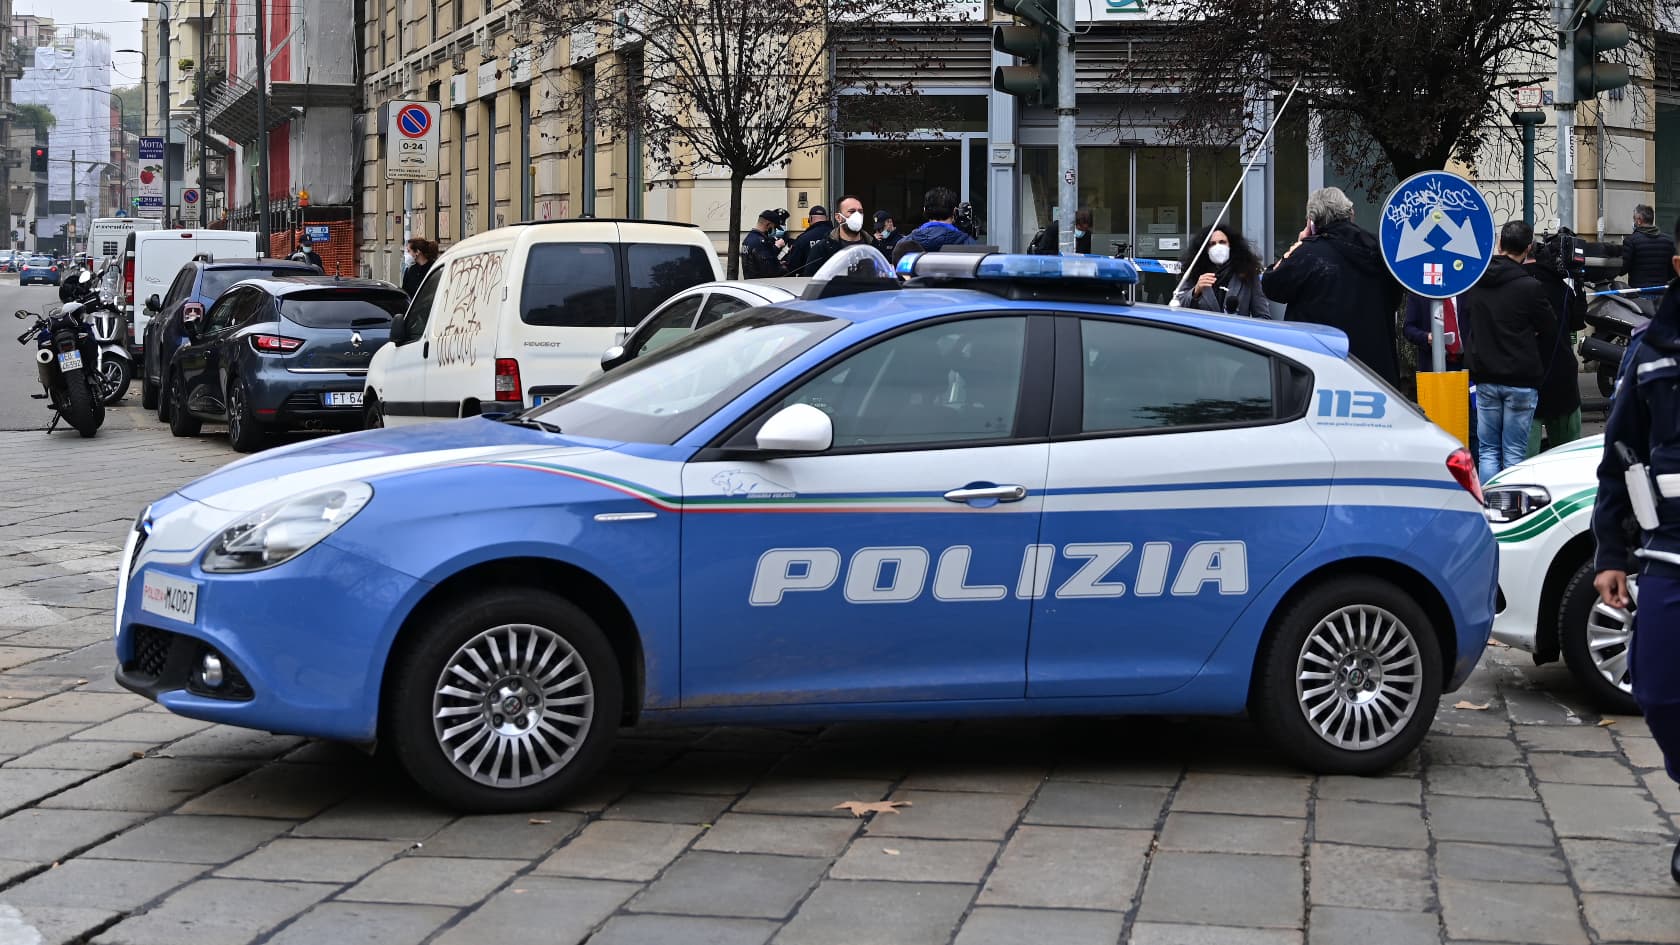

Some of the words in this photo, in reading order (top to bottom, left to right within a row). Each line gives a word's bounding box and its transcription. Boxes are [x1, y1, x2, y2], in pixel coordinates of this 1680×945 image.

[402, 142, 423, 150] 0-24
[1316, 389, 1387, 419] 113
[749, 540, 1248, 606] POLIZIA
